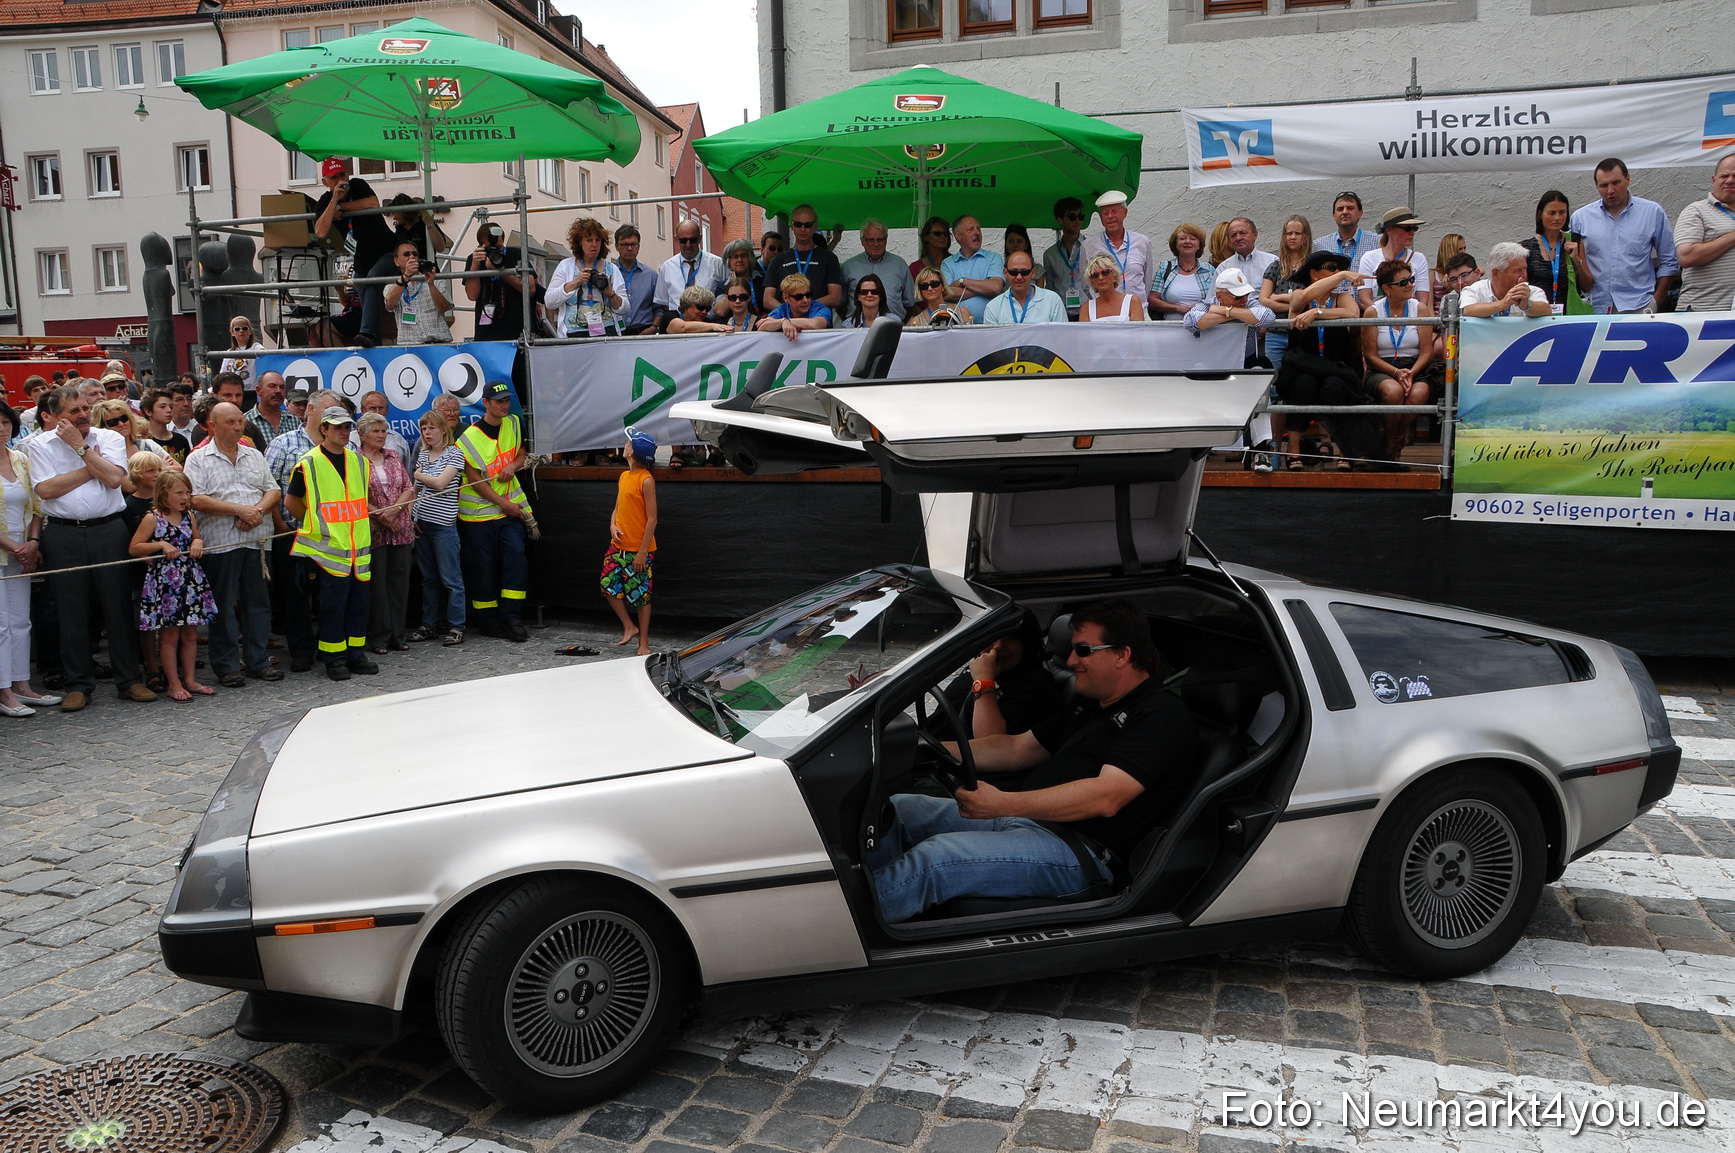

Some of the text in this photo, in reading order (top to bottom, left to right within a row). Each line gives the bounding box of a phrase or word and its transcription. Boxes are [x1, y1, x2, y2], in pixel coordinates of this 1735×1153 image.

[336, 56, 460, 65] Neumarkter
[1416, 104, 1550, 130] Herzlich
[1378, 131, 1587, 160] willkommen
[1469, 434, 1662, 463] Seit über 50 Jahren
[1596, 455, 1735, 480] Ihr Reisepar
[1465, 499, 1735, 522] 90602 Seligenporten Ha
